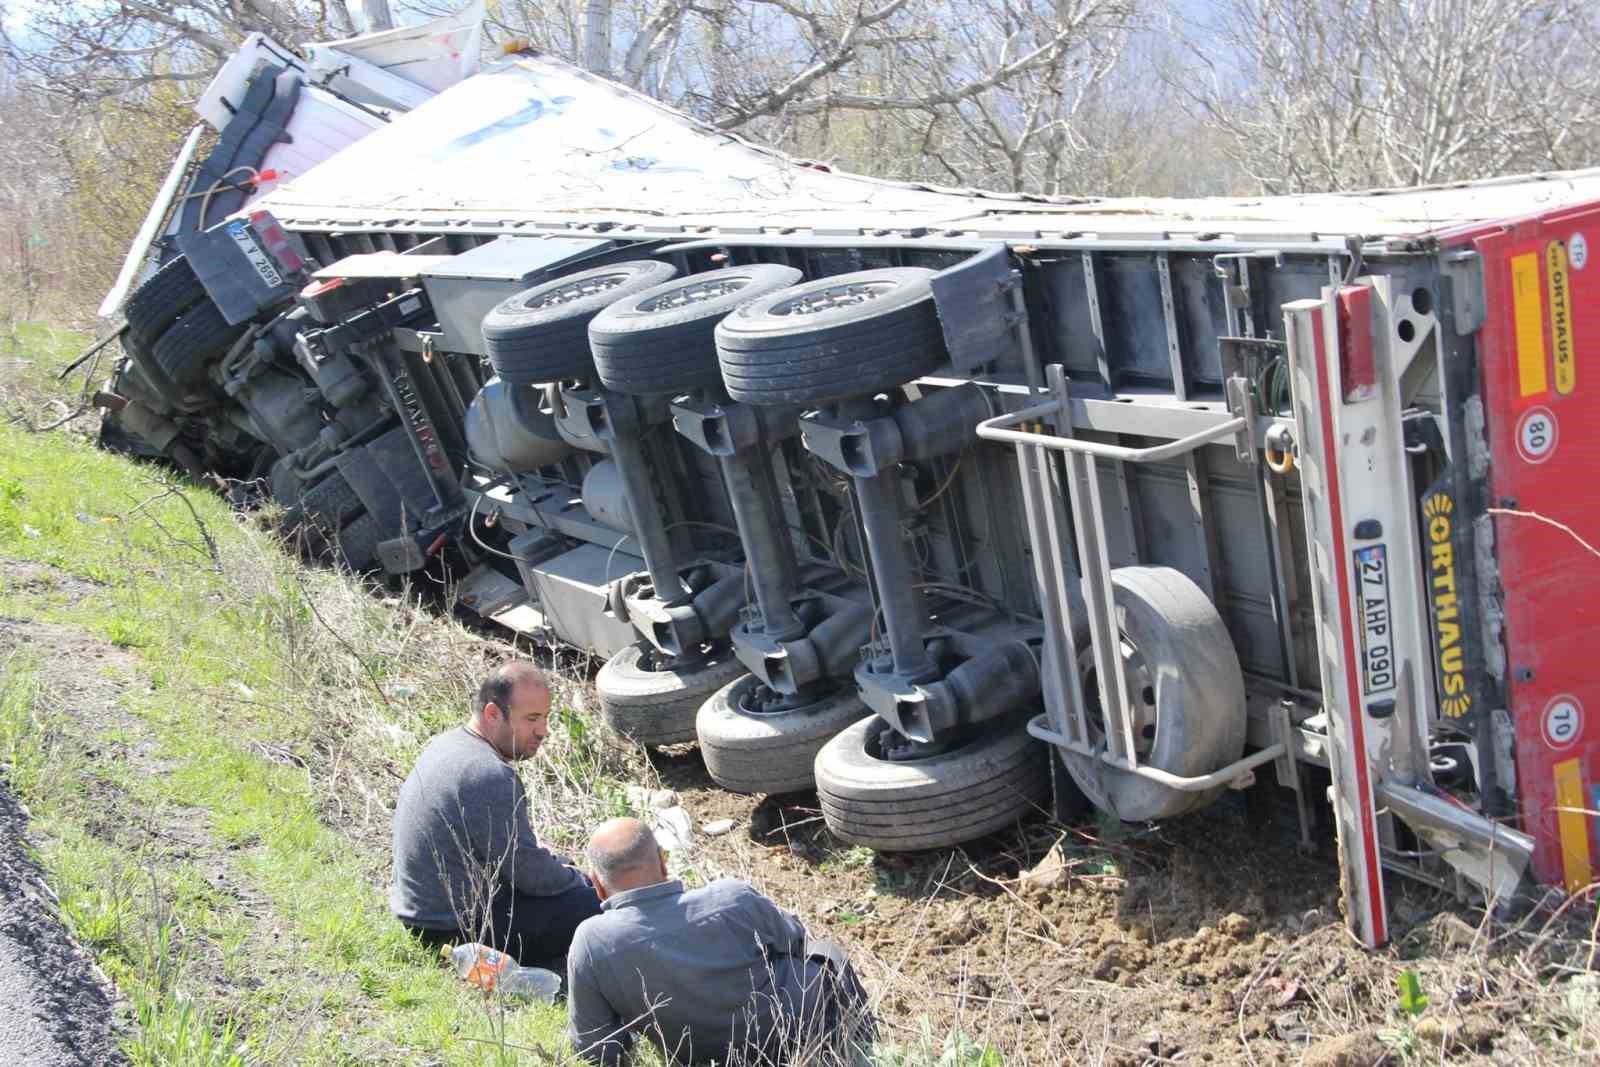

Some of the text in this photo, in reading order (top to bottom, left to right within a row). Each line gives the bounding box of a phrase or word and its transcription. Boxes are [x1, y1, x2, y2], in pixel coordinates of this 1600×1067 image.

[1553, 271, 1569, 364] ORTHAUS
[1529, 421, 1545, 448] 80
[1363, 560, 1390, 686] 27 AHP 090
[1429, 515, 1465, 696] ORTHAUS
[1554, 709, 1571, 736] 70
